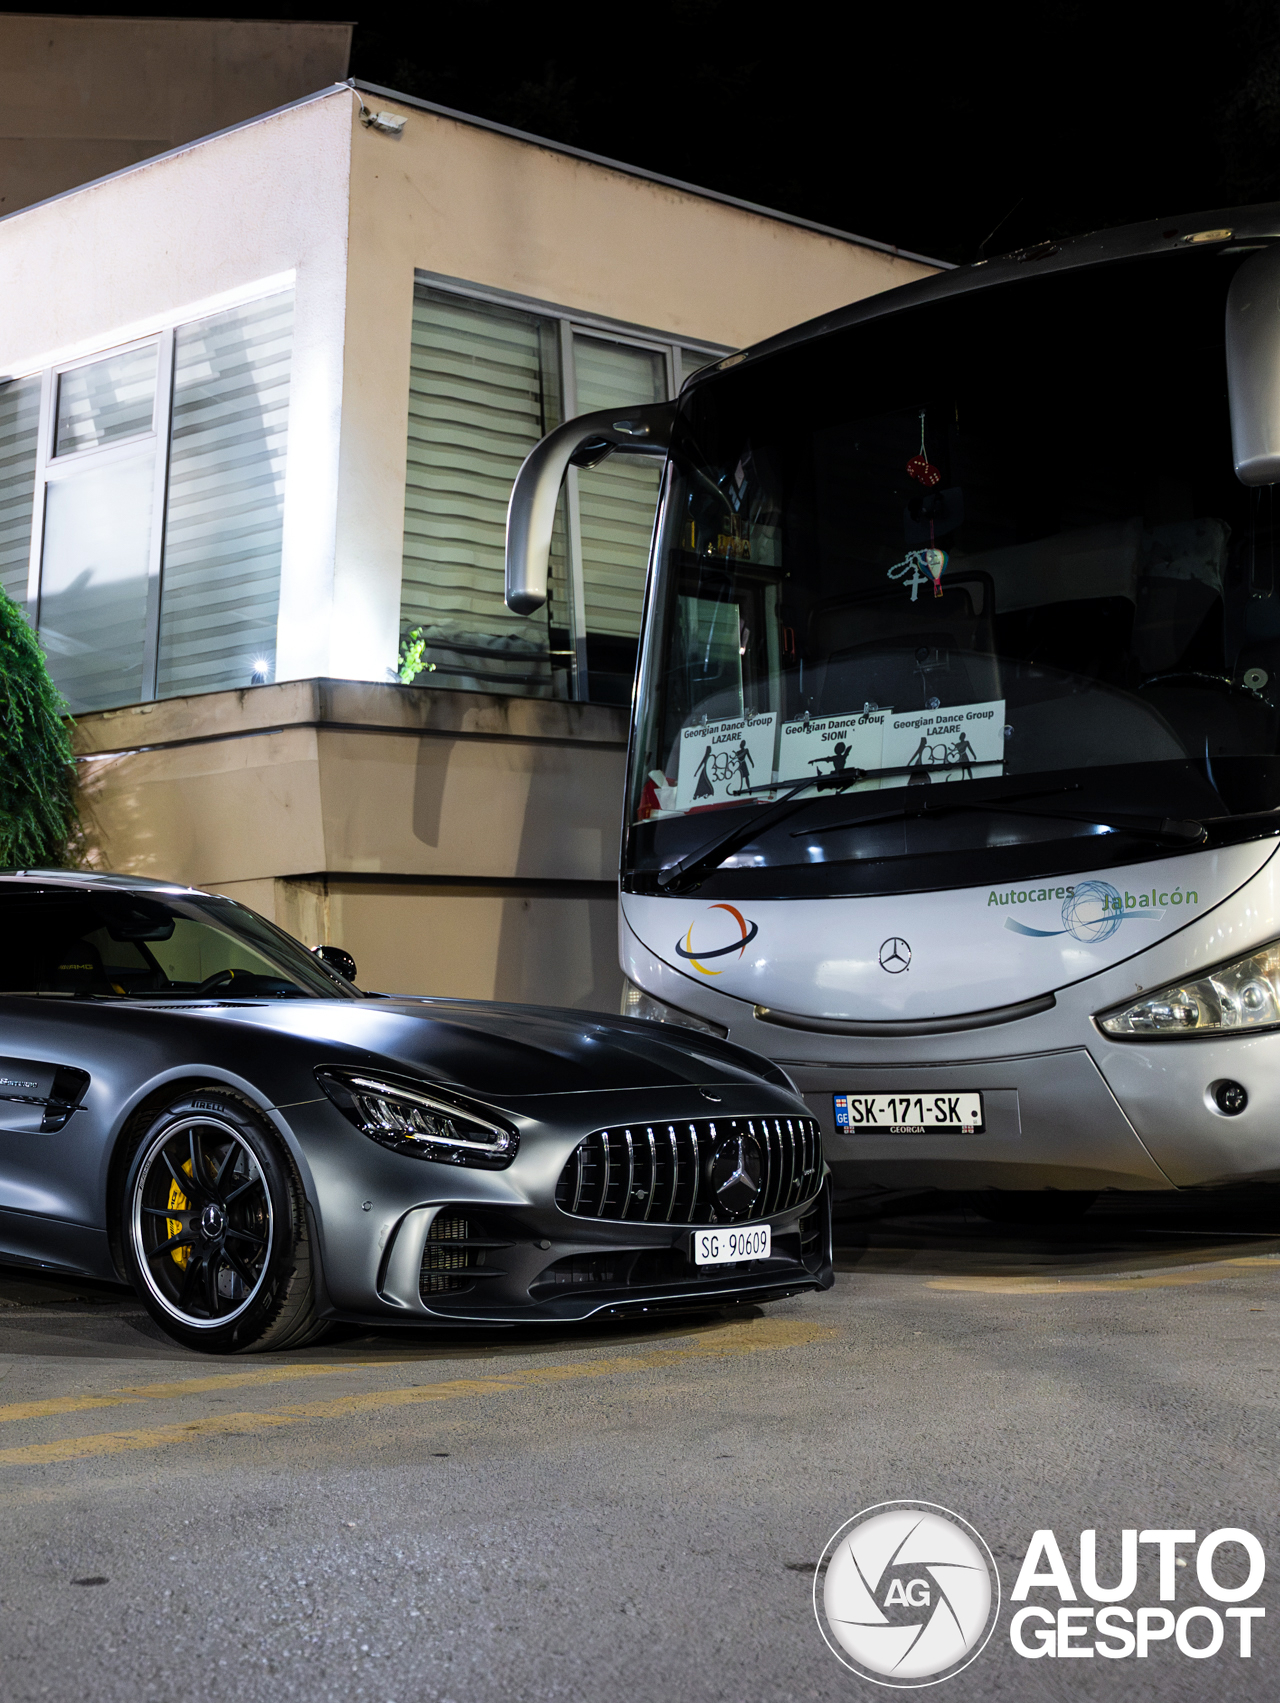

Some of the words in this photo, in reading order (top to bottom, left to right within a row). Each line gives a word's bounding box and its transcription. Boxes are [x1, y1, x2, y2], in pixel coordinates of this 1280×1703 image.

[785, 723, 826, 735] Georgian
[828, 719, 856, 729] Dance
[893, 717, 934, 729] Georgian
[936, 714, 964, 724] Dance
[966, 710, 994, 720] Group
[684, 725, 719, 739] Georgian
[721, 721, 745, 732] Dance
[747, 717, 772, 728] Group
[821, 730, 847, 741] SIONI
[926, 724, 961, 736] LAZARE
[712, 732, 742, 744] LAZARE
[987, 885, 1075, 907] Autocares
[1102, 887, 1199, 911] Jabalcón
[191, 1101, 225, 1112] PIRELLI
[837, 1113, 849, 1124] GE
[851, 1097, 962, 1123] SK-171-SK
[890, 1126, 925, 1134] GEORGIA
[729, 1230, 767, 1257] 90609
